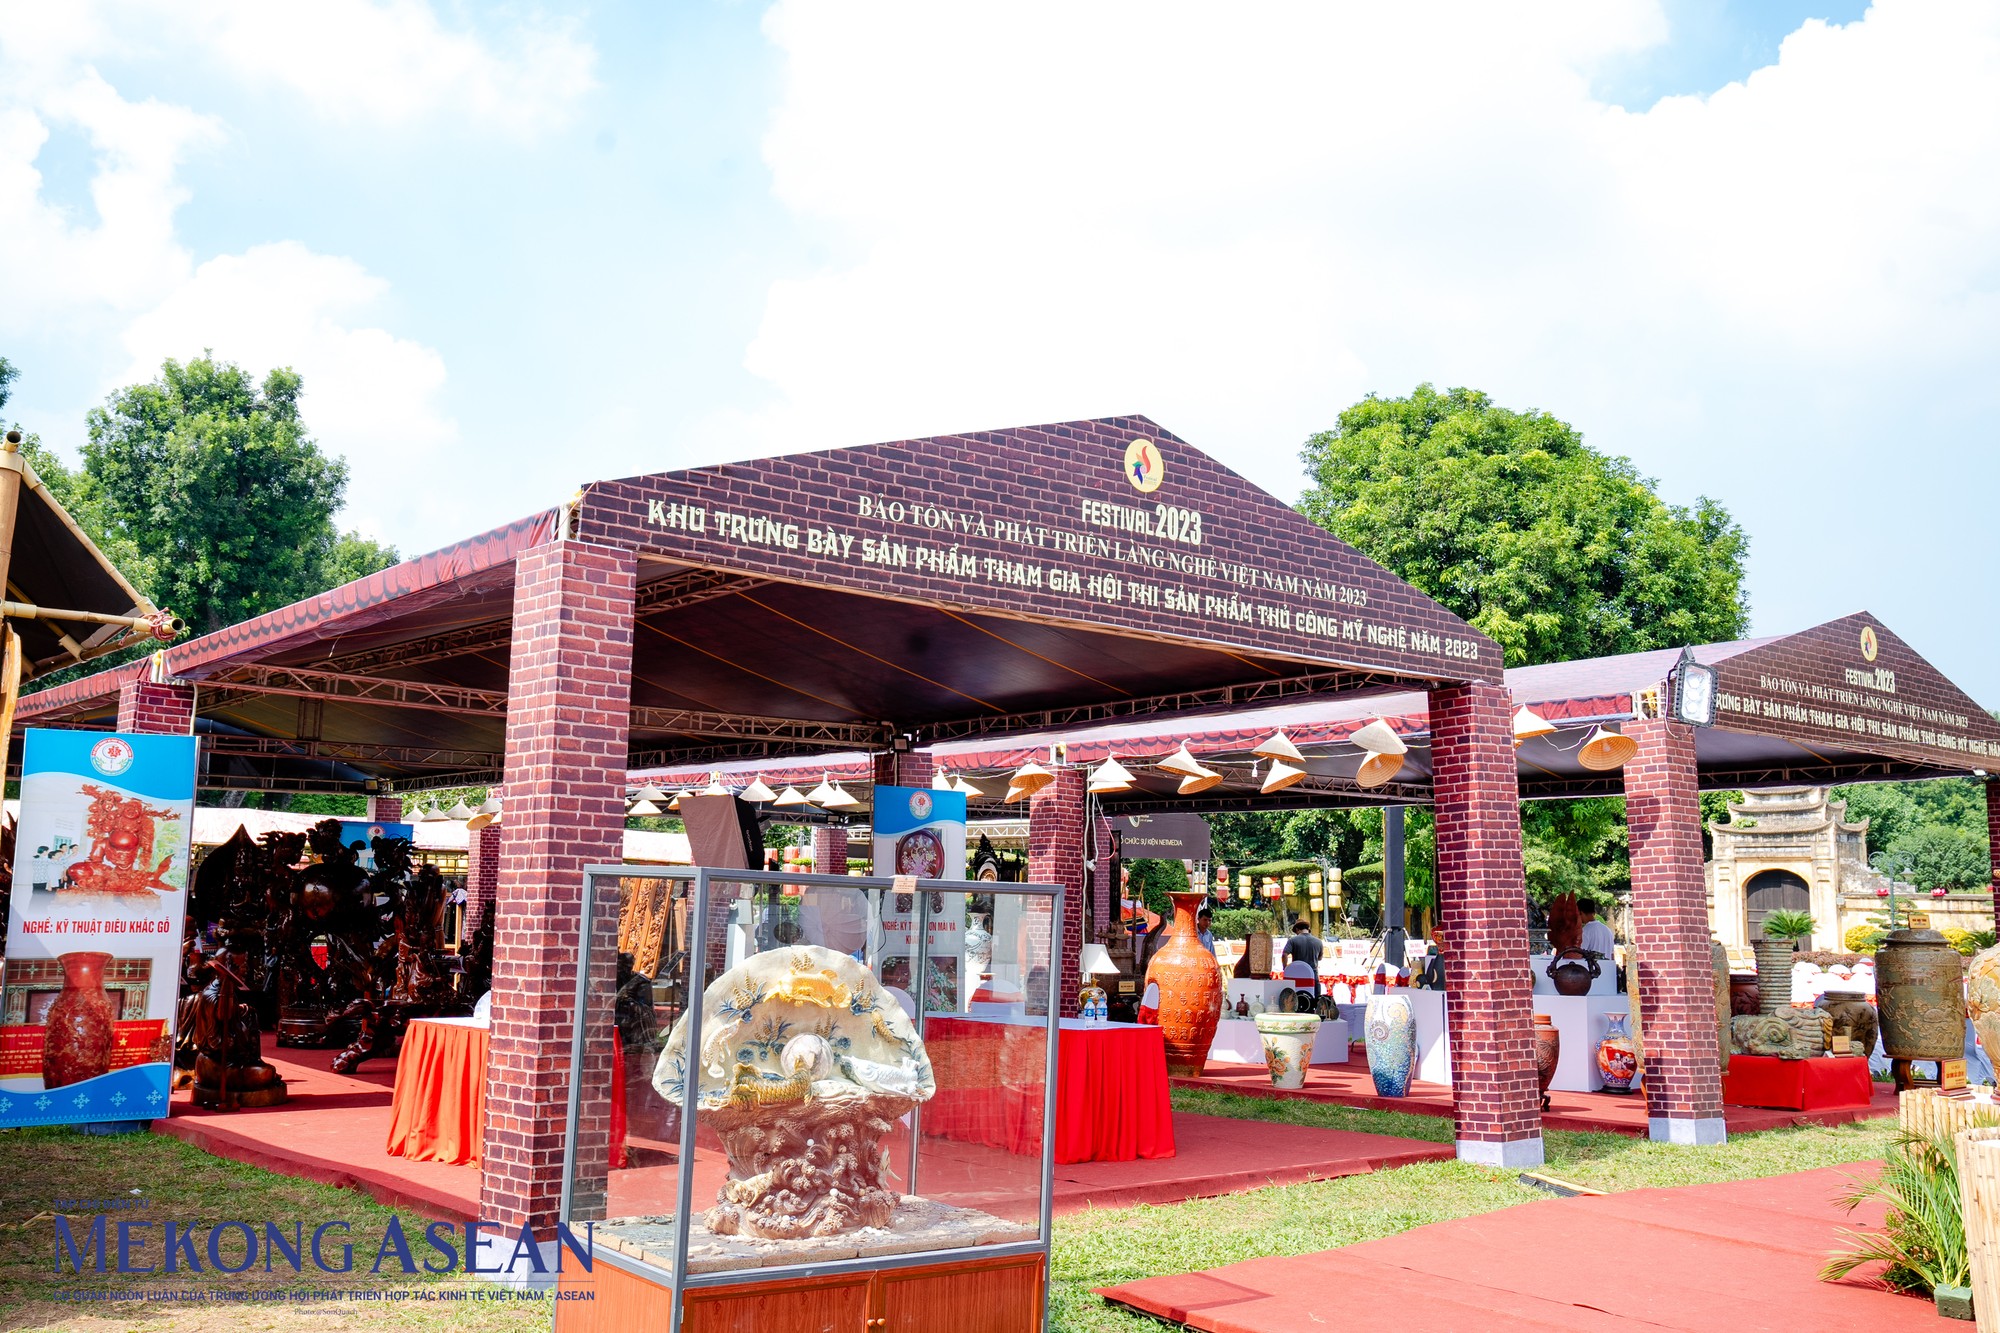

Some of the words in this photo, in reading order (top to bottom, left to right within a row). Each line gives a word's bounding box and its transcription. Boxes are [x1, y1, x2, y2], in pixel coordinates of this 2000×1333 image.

[858, 492, 905, 522] BẢO
[910, 502, 954, 532] TỒN
[960, 511, 988, 537] VÀ
[994, 520, 1048, 547] PHÁT
[1051, 530, 1110, 559] TRIỂN
[1114, 539, 1165, 568] LÀNG
[1169, 552, 1217, 578] NGHỀ
[1221, 562, 1259, 588] VIỆT
[1262, 571, 1299, 594] NAM
[1302, 577, 1337, 601] NĂM
[1340, 585, 1367, 607] 2023
[1081, 499, 1155, 536] FESTIVAL
[1155, 504, 1202, 546] 2023
[648, 498, 705, 533] KHU
[714, 510, 799, 549] TRƯNG
[807, 526, 855, 558] BÀY
[862, 534, 907, 568] SẢN
[915, 543, 977, 578] PHẨM
[984, 557, 1042, 588] THAM
[1049, 568, 1081, 594] GIA
[1087, 573, 1122, 603] HỘI
[1128, 581, 1158, 607] THI
[1164, 585, 1199, 613] SẢN
[1205, 592, 1253, 623] PHẨM
[1257, 604, 1290, 630] THỦ
[1296, 610, 1338, 637] CÔNG
[1342, 619, 1363, 641] MỸ
[1367, 624, 1407, 653] NGHỆ
[1411, 630, 1440, 654] NĂM
[1445, 638, 1478, 660] 2023
[1760, 673, 1779, 690] BẢO
[1798, 681, 1810, 696] VÀ
[1812, 684, 1834, 700] PHÁT
[1860, 692, 1881, 710] LÀNG
[1904, 703, 1920, 720] VIỆT
[1921, 708, 1938, 722] NAM
[1938, 710, 1954, 725] NĂM
[1955, 715, 1968, 728] 2023
[1845, 668, 1875, 689] FESTIVAL
[1875, 667, 1896, 694] 2023
[1715, 692, 1741, 711] RƯNG
[1743, 696, 1761, 715] BÀY
[1763, 698, 1781, 718] SẢN
[1783, 701, 1808, 723] PHẨM
[1809, 709, 1834, 727] THAM
[1835, 714, 1849, 729] GIA
[1850, 715, 1865, 734] HỘI
[1866, 719, 1880, 735] THI
[1881, 720, 1897, 738] SẢN
[1937, 732, 1957, 749] CÔNG
[55, 918, 69, 933] KỸ
[71, 918, 102, 936] THUẬT
[104, 918, 127, 933] ĐIÊU
[129, 916, 155, 933] KHẮC
[157, 916, 170, 933] GỖ
